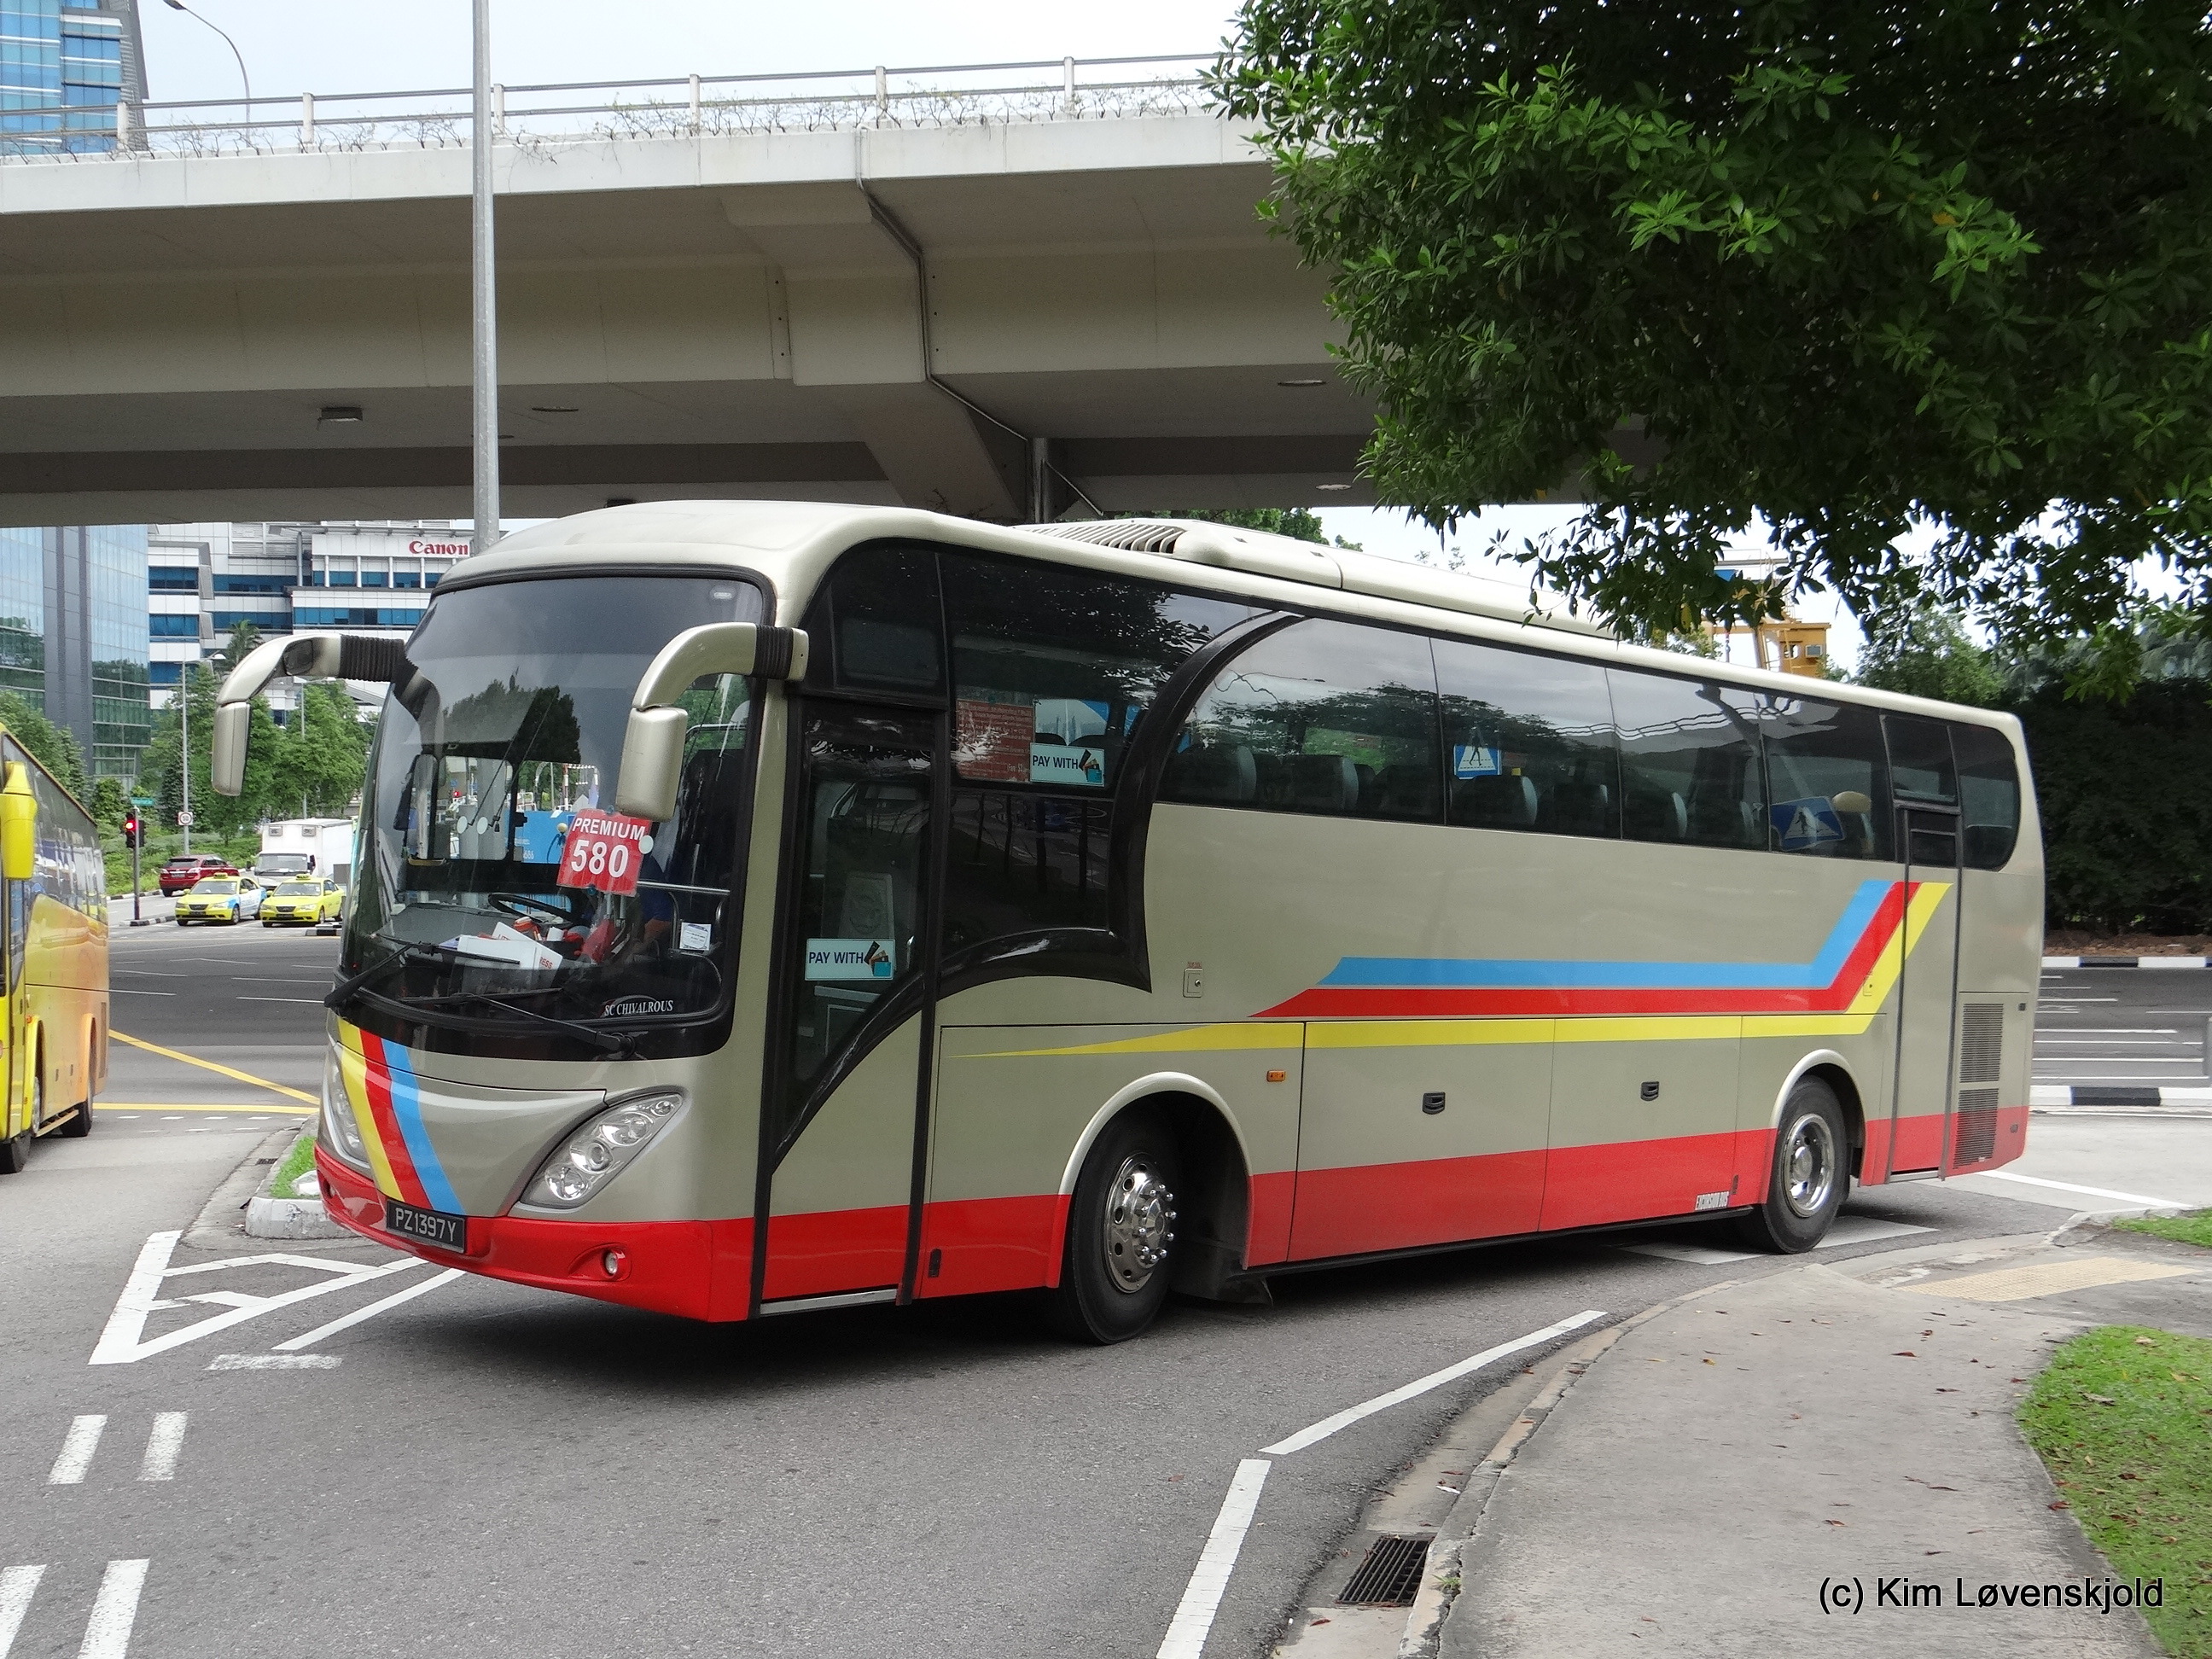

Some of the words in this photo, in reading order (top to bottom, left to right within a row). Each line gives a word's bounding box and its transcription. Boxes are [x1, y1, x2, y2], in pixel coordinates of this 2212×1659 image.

[409, 540, 469, 556] Canon
[1032, 754, 1051, 767] PAY
[1052, 756, 1079, 770] WITH
[572, 818, 646, 841] PREMIUM
[571, 839, 629, 878] 580
[808, 952, 830, 964] PAY
[834, 952, 864, 964] WITH
[604, 1004, 615, 1016] SC
[616, 999, 674, 1016] CHIVALROUS
[395, 1207, 457, 1242] PZ1397Y
